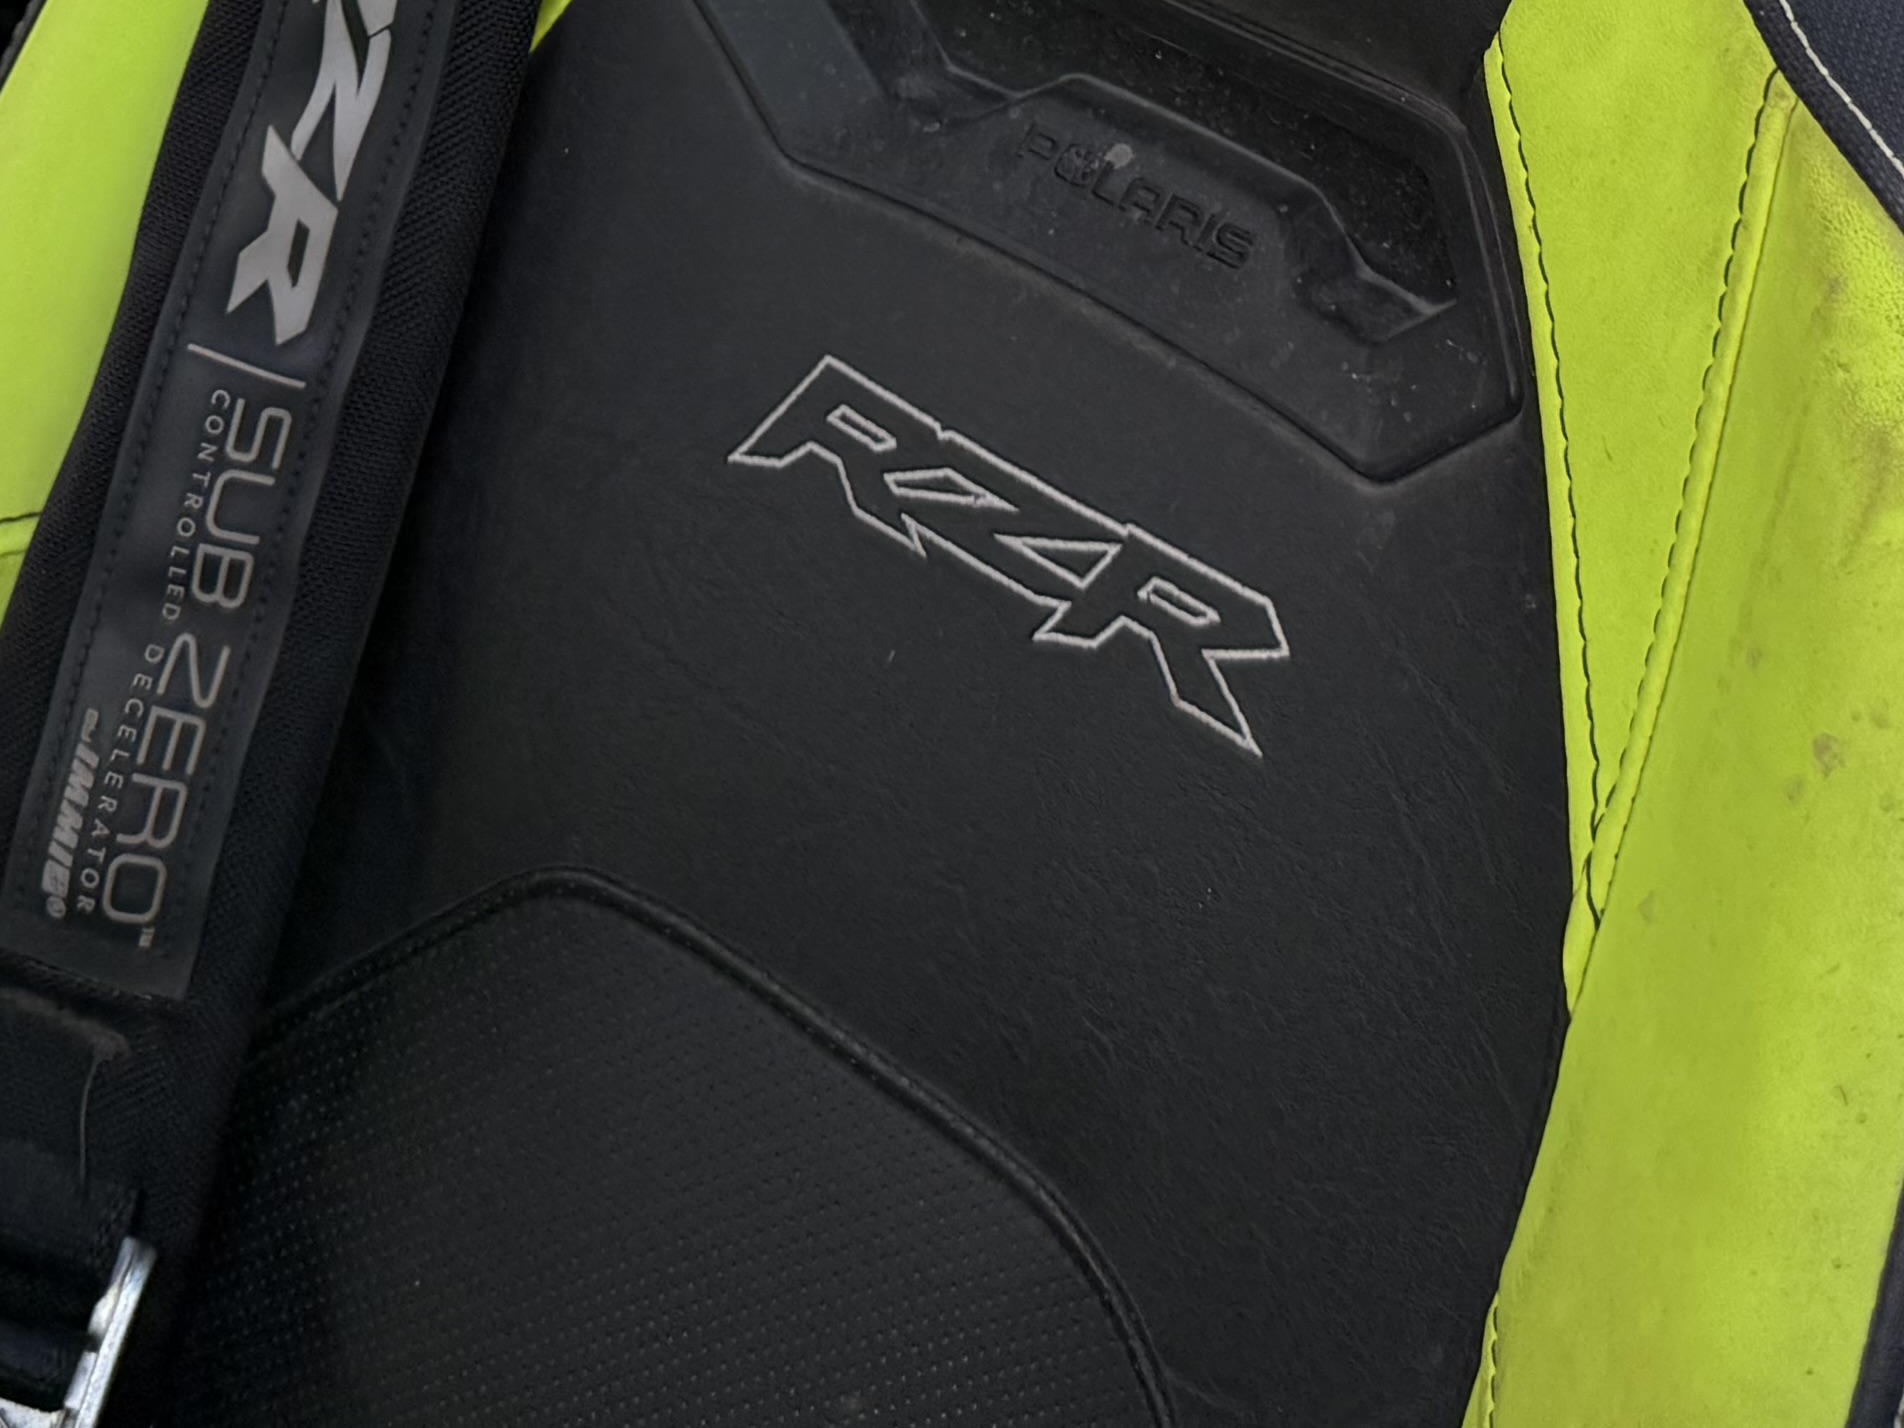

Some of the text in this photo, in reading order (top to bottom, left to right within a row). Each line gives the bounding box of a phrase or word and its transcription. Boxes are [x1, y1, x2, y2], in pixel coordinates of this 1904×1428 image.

[1014, 122, 1254, 271] POLARIS
[76, 388, 230, 915] CONTROLLED DECELERATOR
[191, 397, 293, 609] SUB
[727, 354, 1290, 758] RZR
